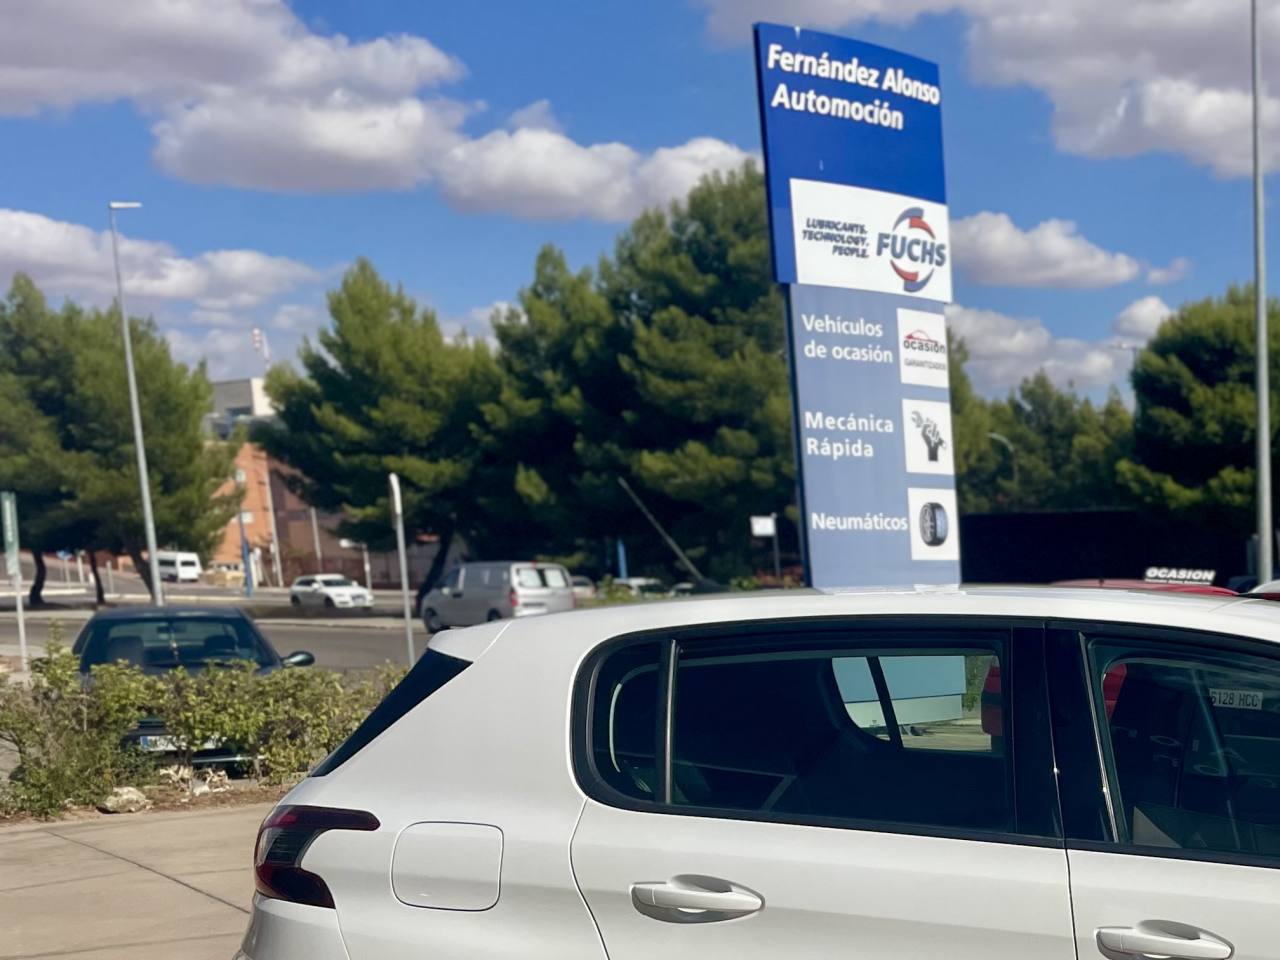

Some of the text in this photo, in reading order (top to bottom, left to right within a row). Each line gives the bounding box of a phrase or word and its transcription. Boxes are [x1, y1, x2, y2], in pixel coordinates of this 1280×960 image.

[767, 43, 941, 105] Fernández Alonso
[771, 83, 904, 130] Automoción
[876, 232, 946, 267] FUCHS
[802, 314, 884, 337] Vehículos
[804, 340, 894, 363] de ocasión
[805, 411, 894, 433] Mecánica
[807, 437, 875, 460] Rápida
[811, 511, 908, 531] Neumáticos
[1145, 566, 1216, 581] OCASION
